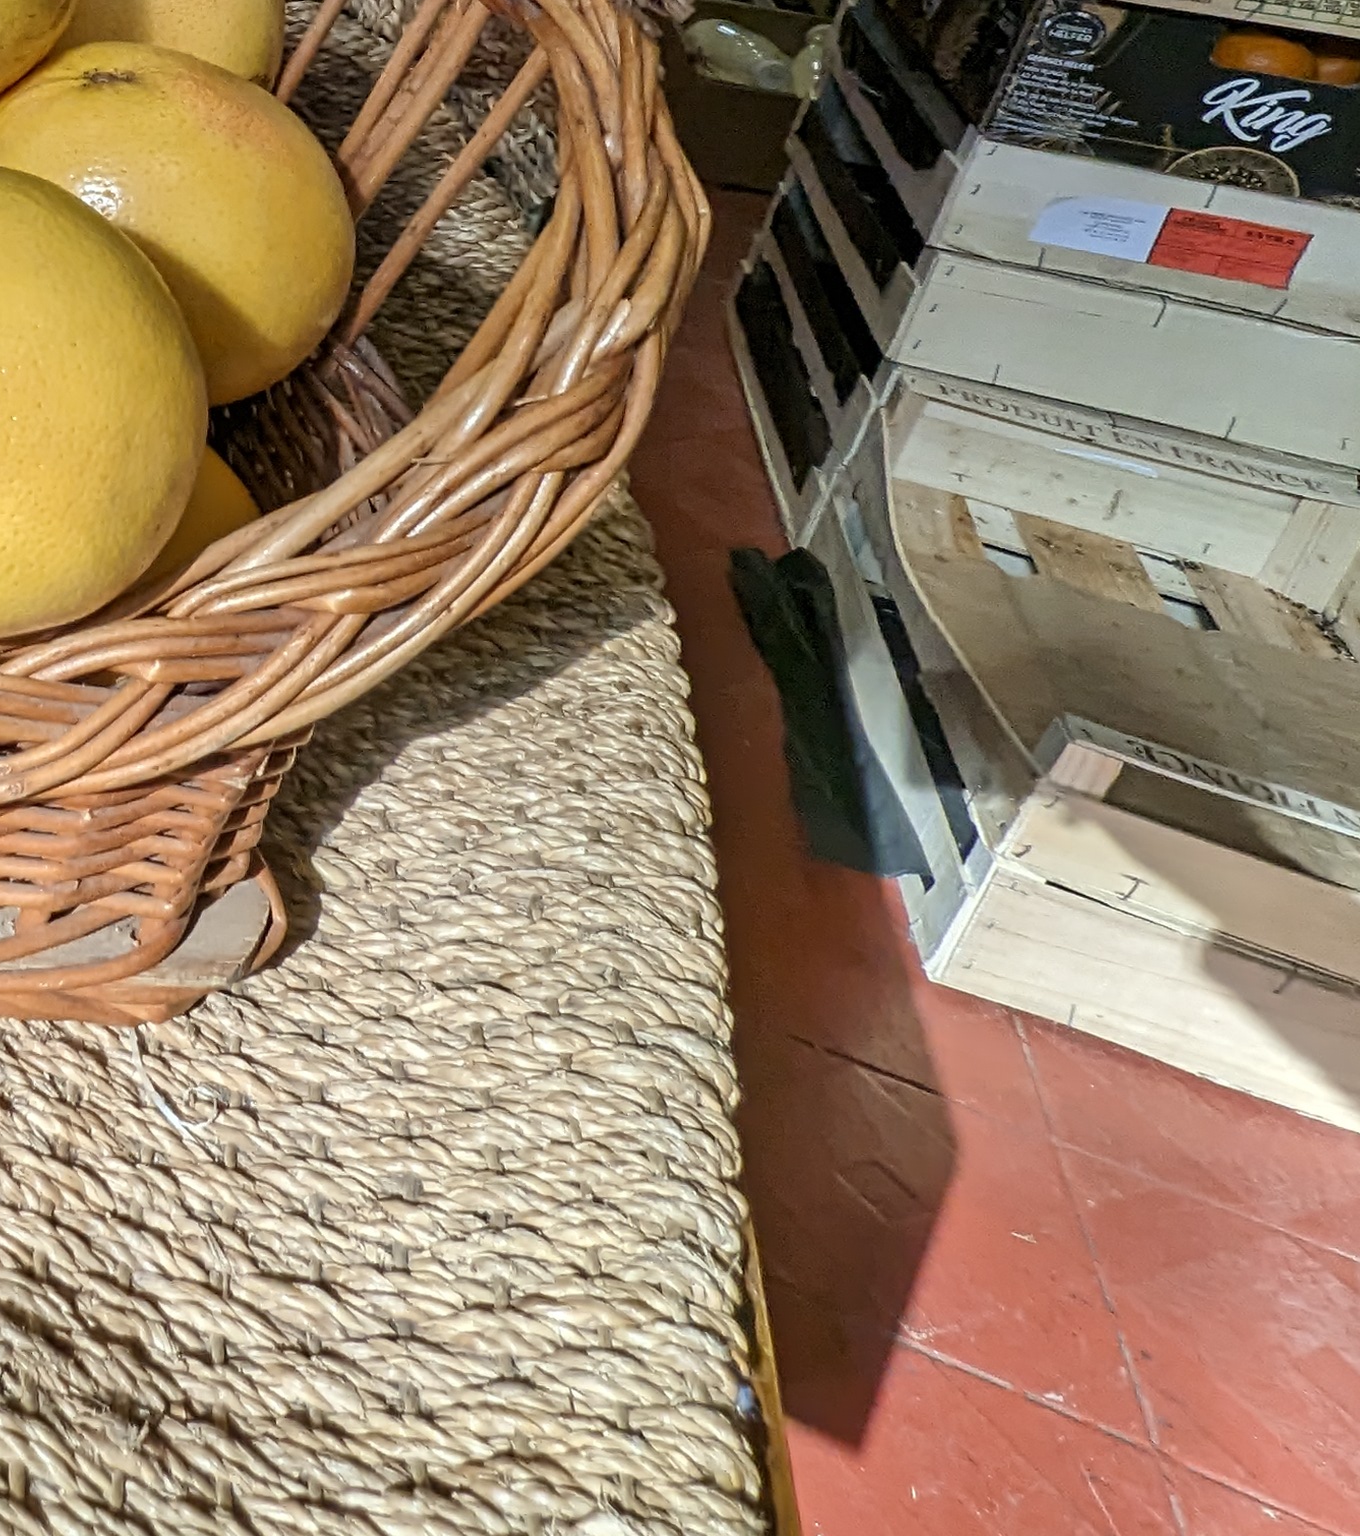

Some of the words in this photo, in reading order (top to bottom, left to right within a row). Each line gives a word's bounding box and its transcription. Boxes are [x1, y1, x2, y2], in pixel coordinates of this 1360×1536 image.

[1201, 78, 1332, 152] King
[938, 382, 1105, 438] PRODUIT
[1110, 430, 1162, 455] EN
[1171, 446, 1330, 495] FRANCE
